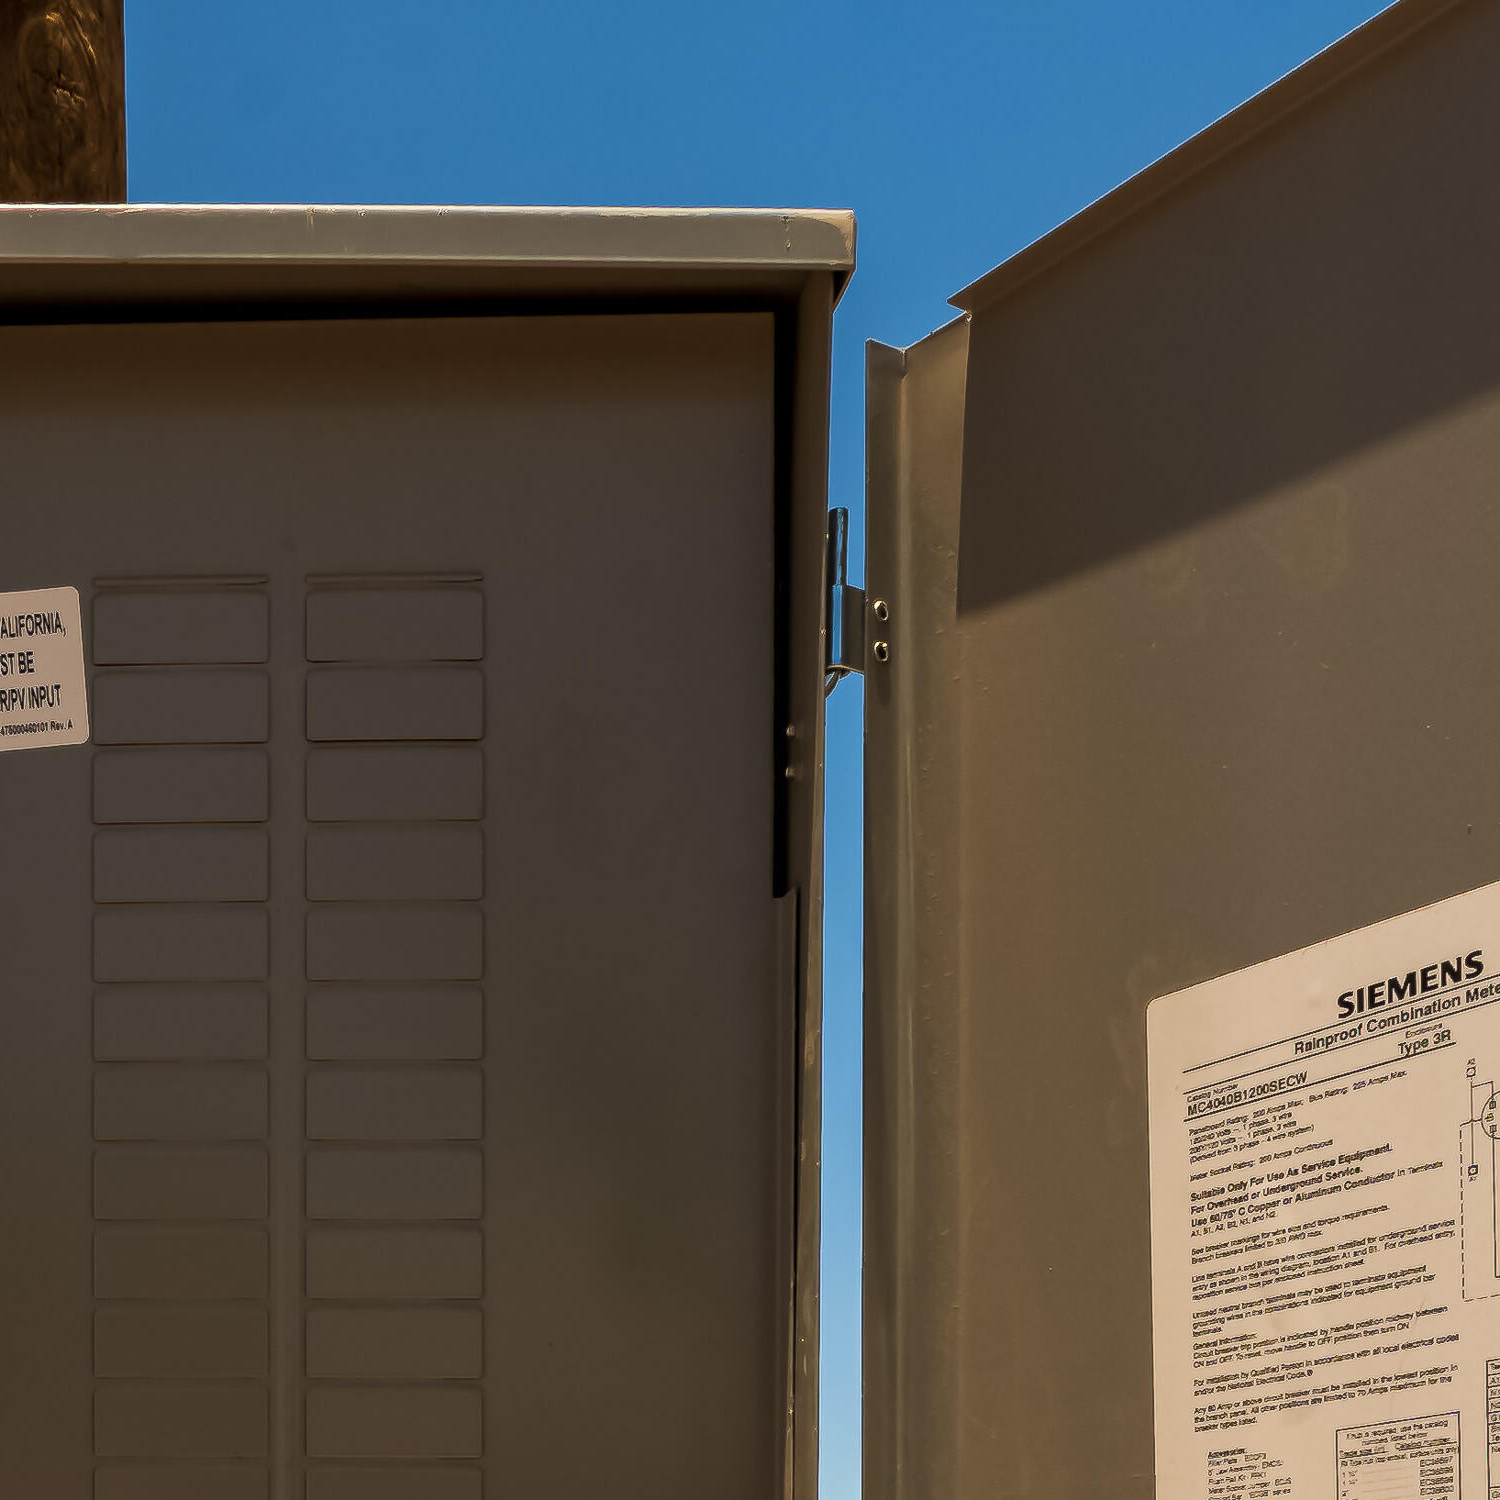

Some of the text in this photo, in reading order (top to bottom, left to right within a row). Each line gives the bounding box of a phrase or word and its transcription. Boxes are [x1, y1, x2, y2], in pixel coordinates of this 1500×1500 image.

[18, 651, 35, 674] BE
[28, 684, 61, 709] INPUT
[67, 719, 73, 729] A
[1337, 949, 1485, 1019] SIEMENS
[1294, 1023, 1363, 1055] Rainproof
[1366, 994, 1461, 1033] Combination
[1398, 1029, 1451, 1058] Type 3R
[1227, 1180, 1248, 1194] Only
[1249, 1176, 1265, 1187] For
[1266, 1171, 1285, 1182] Use
[1286, 1167, 1299, 1178] As
[1301, 1159, 1336, 1174] Service
[1238, 1207, 1246, 1216] C
[1247, 1199, 1280, 1214] Copper
[1295, 1184, 1341, 1203] Aluminum
[1343, 1172, 1395, 1191] Conductor
[1190, 1204, 1205, 1215] For
[1206, 1192, 1249, 1211] Overhead
[1262, 1175, 1323, 1198] Underground
